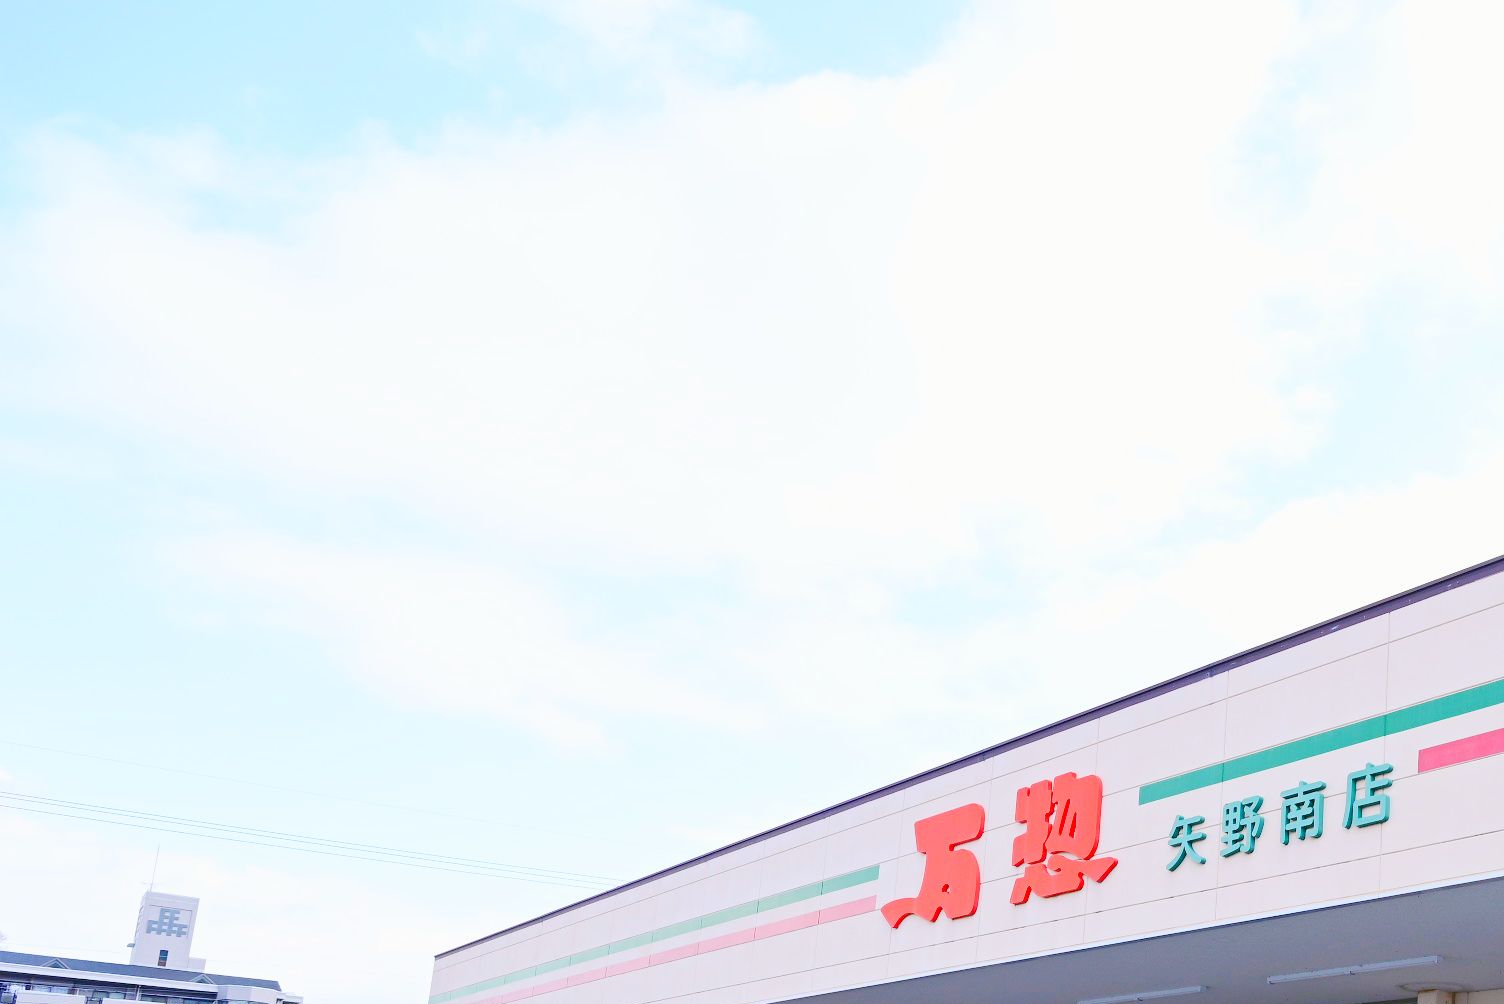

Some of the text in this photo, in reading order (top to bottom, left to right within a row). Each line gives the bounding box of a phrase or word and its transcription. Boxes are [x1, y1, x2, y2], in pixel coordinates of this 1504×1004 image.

[881, 762, 1394, 929] 万惣 矢野南店
